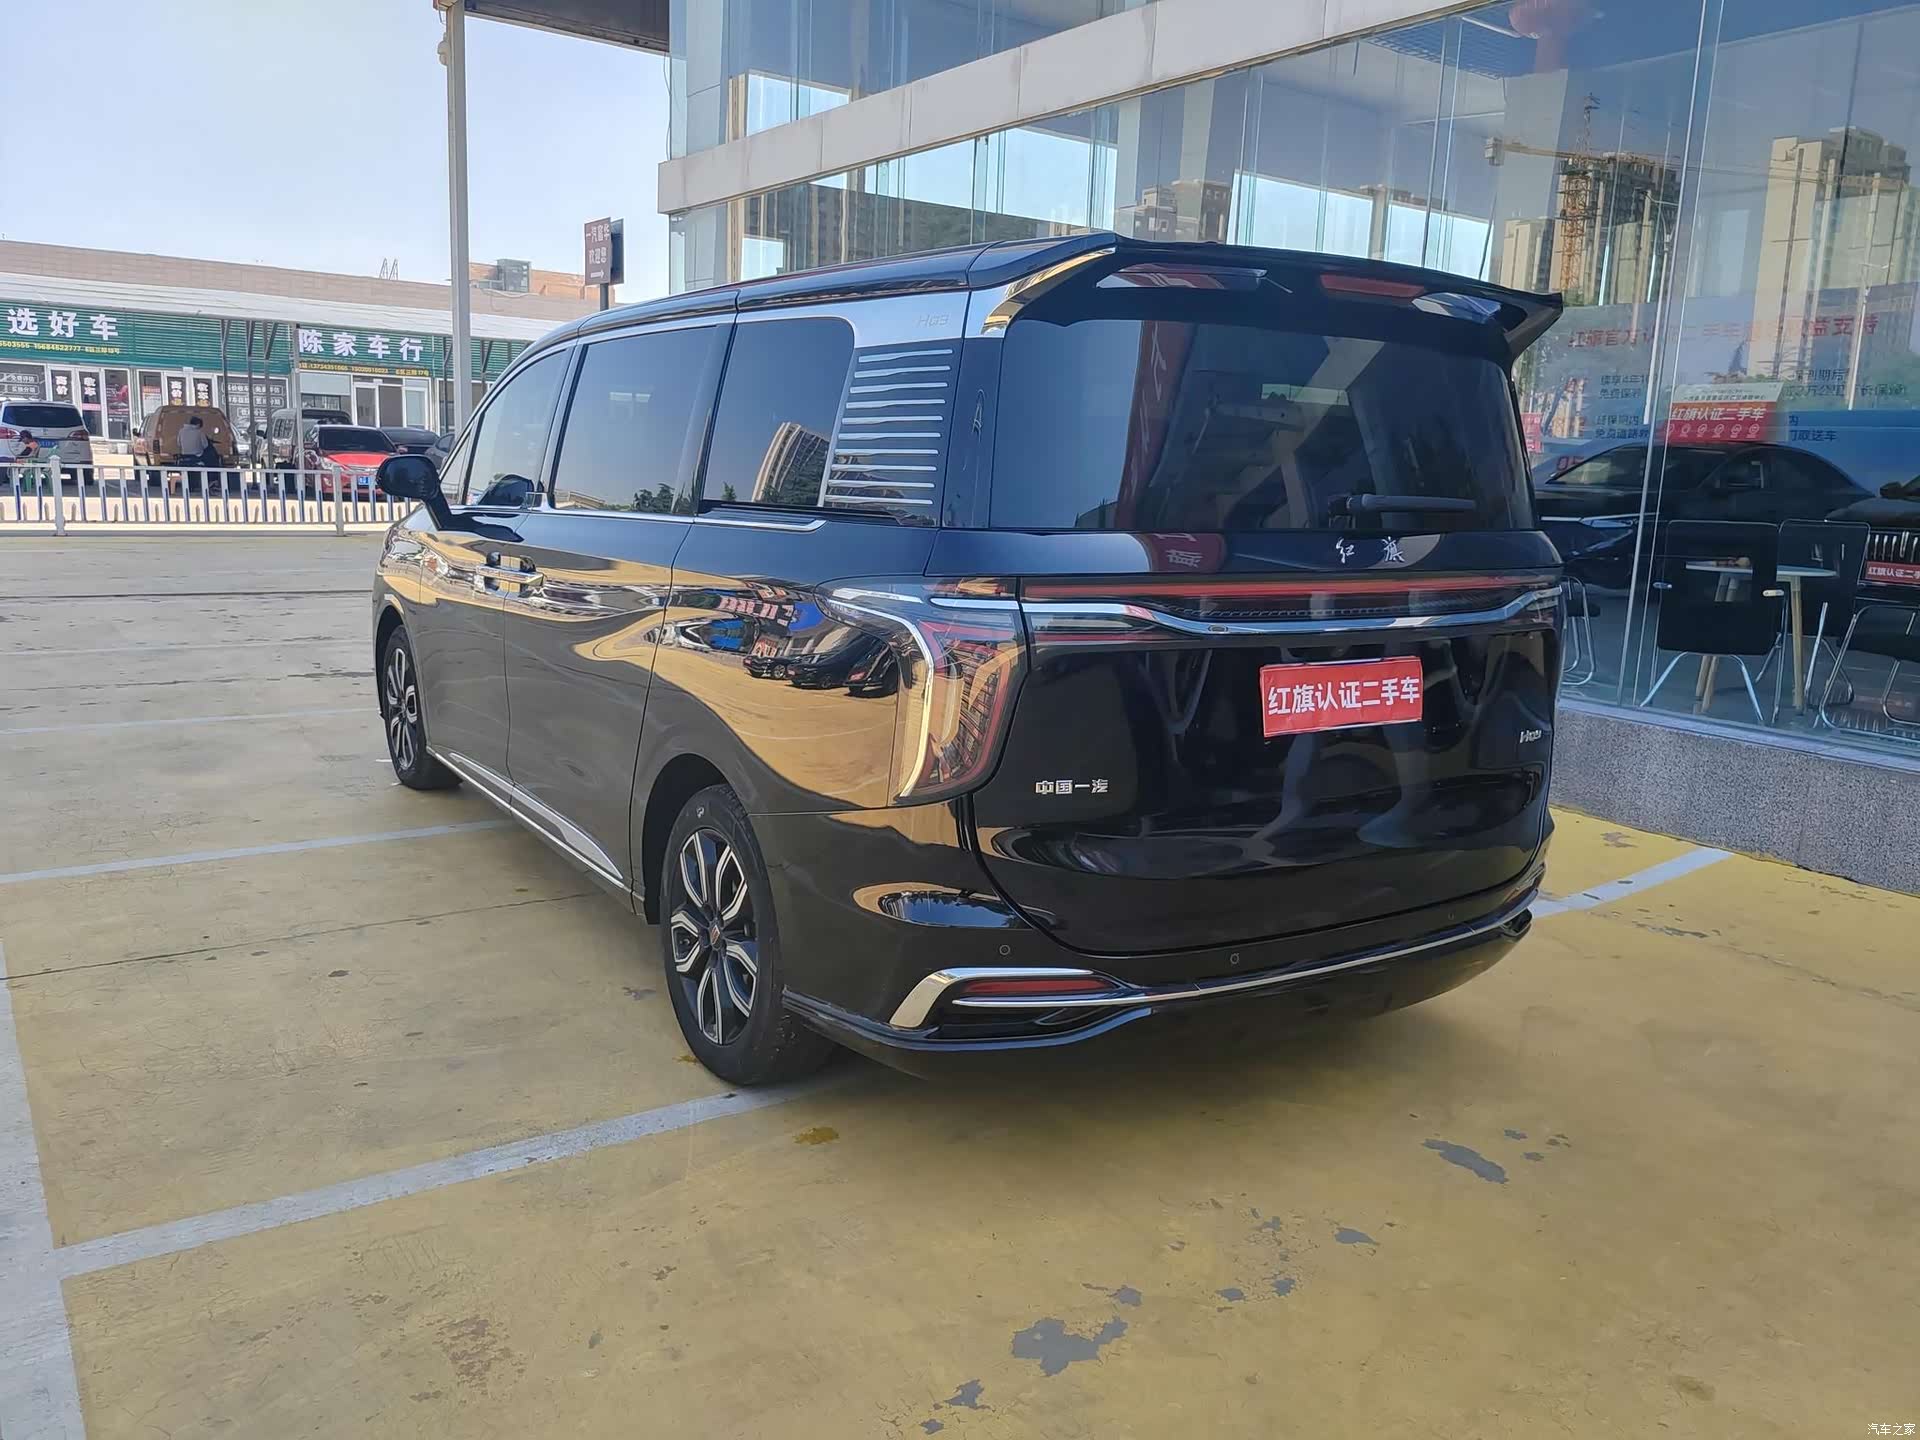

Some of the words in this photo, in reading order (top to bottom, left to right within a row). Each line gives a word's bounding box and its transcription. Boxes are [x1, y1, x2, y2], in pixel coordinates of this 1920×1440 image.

[7, 307, 119, 340] 选好车
[299, 328, 424, 362] 陈家车行
[1669, 407, 1766, 421] 红旗认证二手车
[1335, 536, 1405, 564] 红旗
[1267, 676, 1421, 715] 红旗认证二手车
[1035, 778, 1109, 795] 中国一汽
